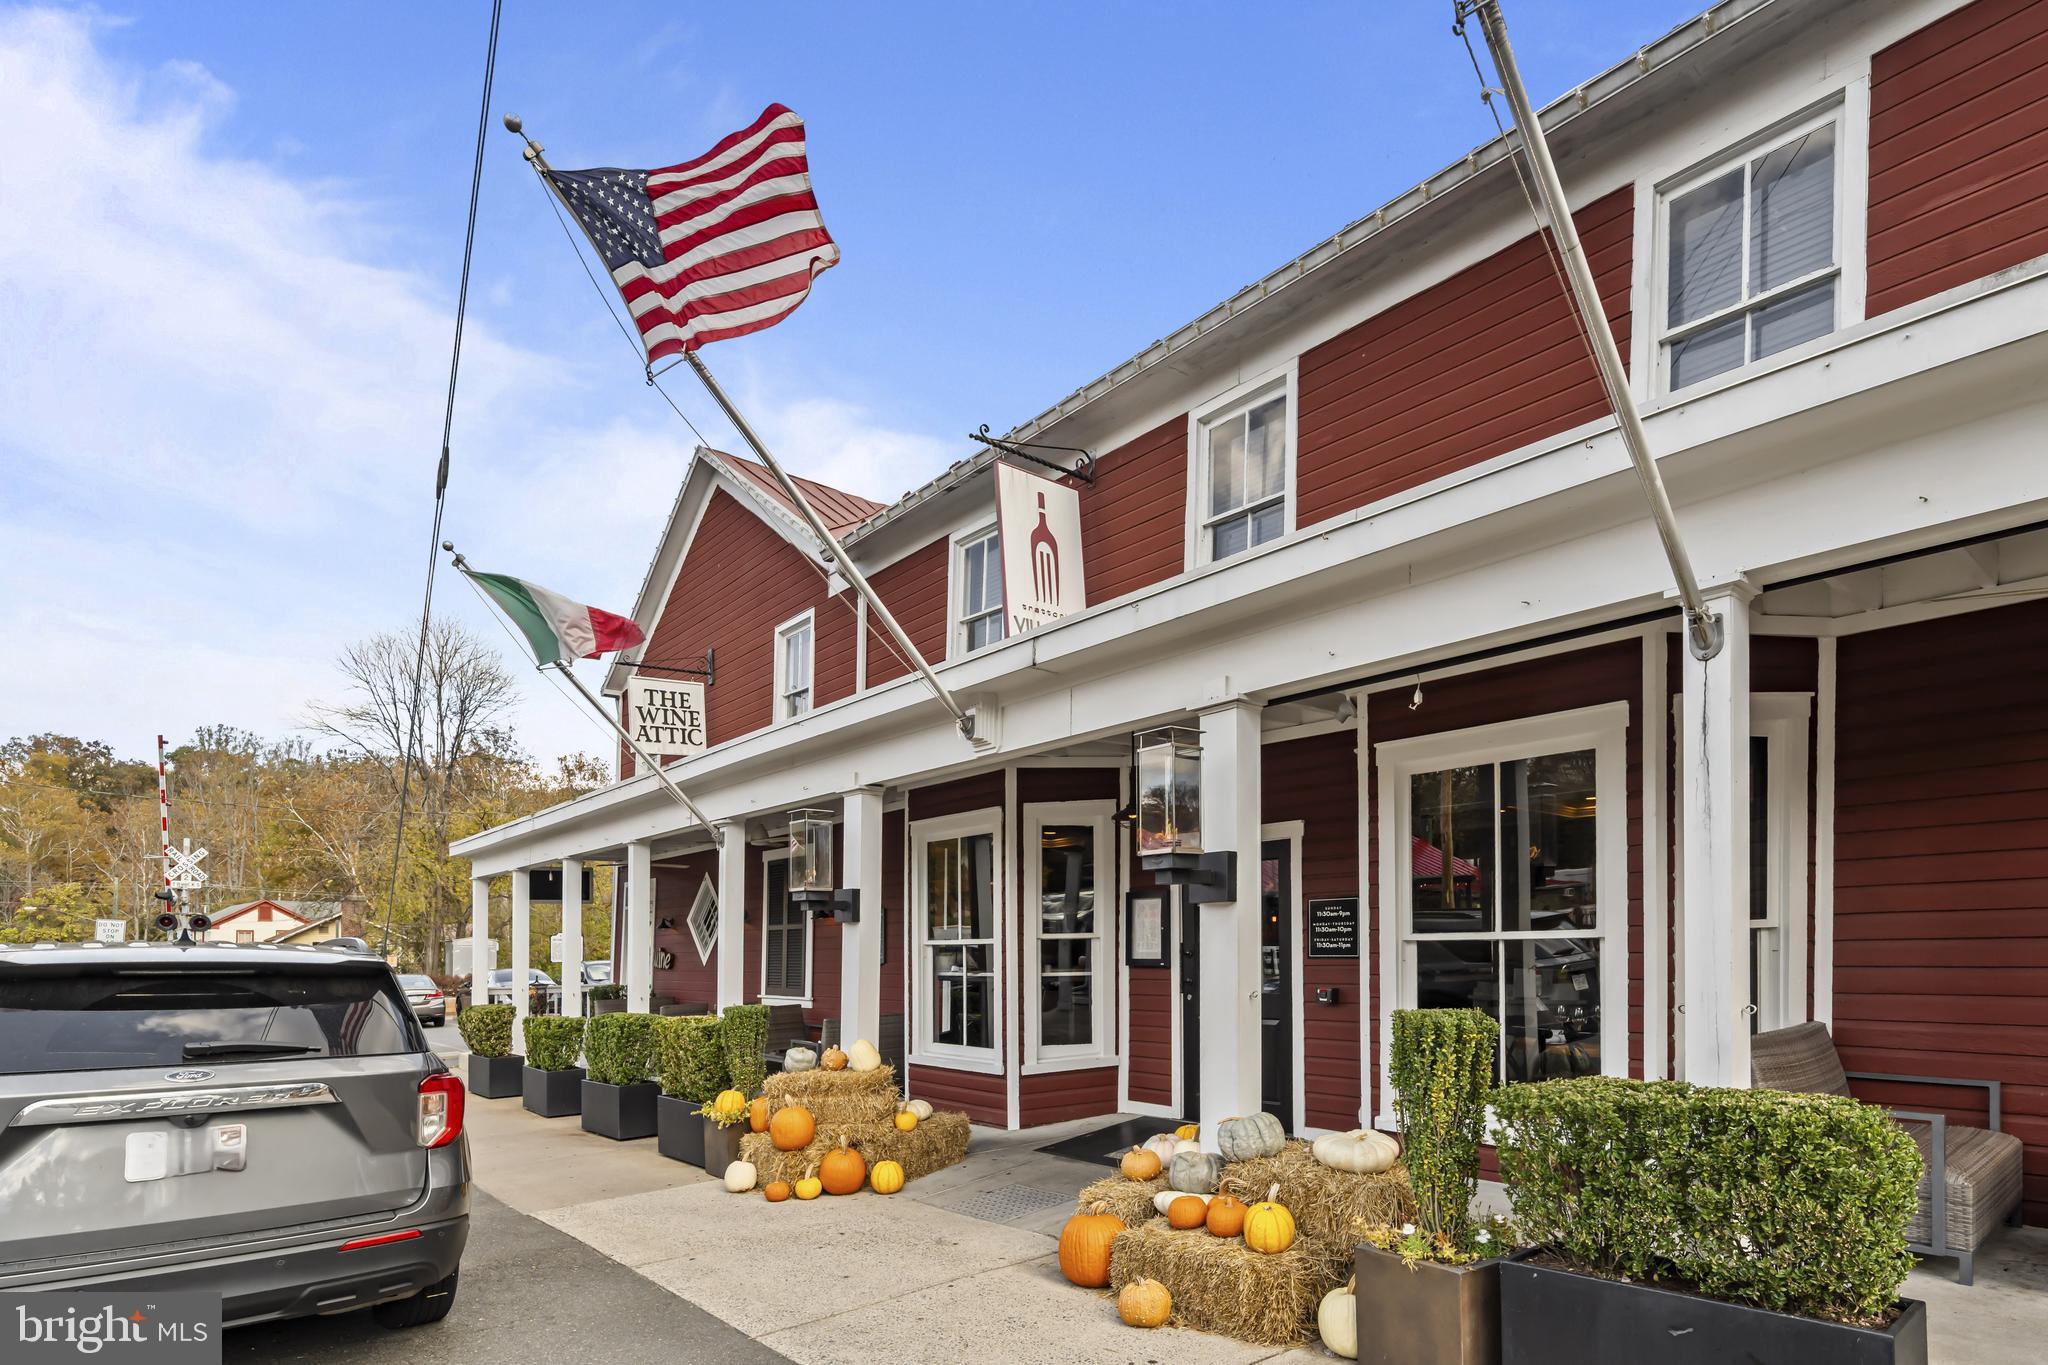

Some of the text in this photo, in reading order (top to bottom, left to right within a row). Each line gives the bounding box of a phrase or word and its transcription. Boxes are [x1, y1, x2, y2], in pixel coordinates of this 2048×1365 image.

[1022, 603, 1065, 618] trattor
[643, 688, 692, 710] THE
[635, 705, 701, 728] WINE
[635, 725, 703, 747] ATTIC
[167, 847, 206, 880] RAIL ROAD
[167, 850, 205, 878] CROSSING
[175, 1071, 204, 1081] Ford
[73, 1091, 293, 1117] EXPLORER
